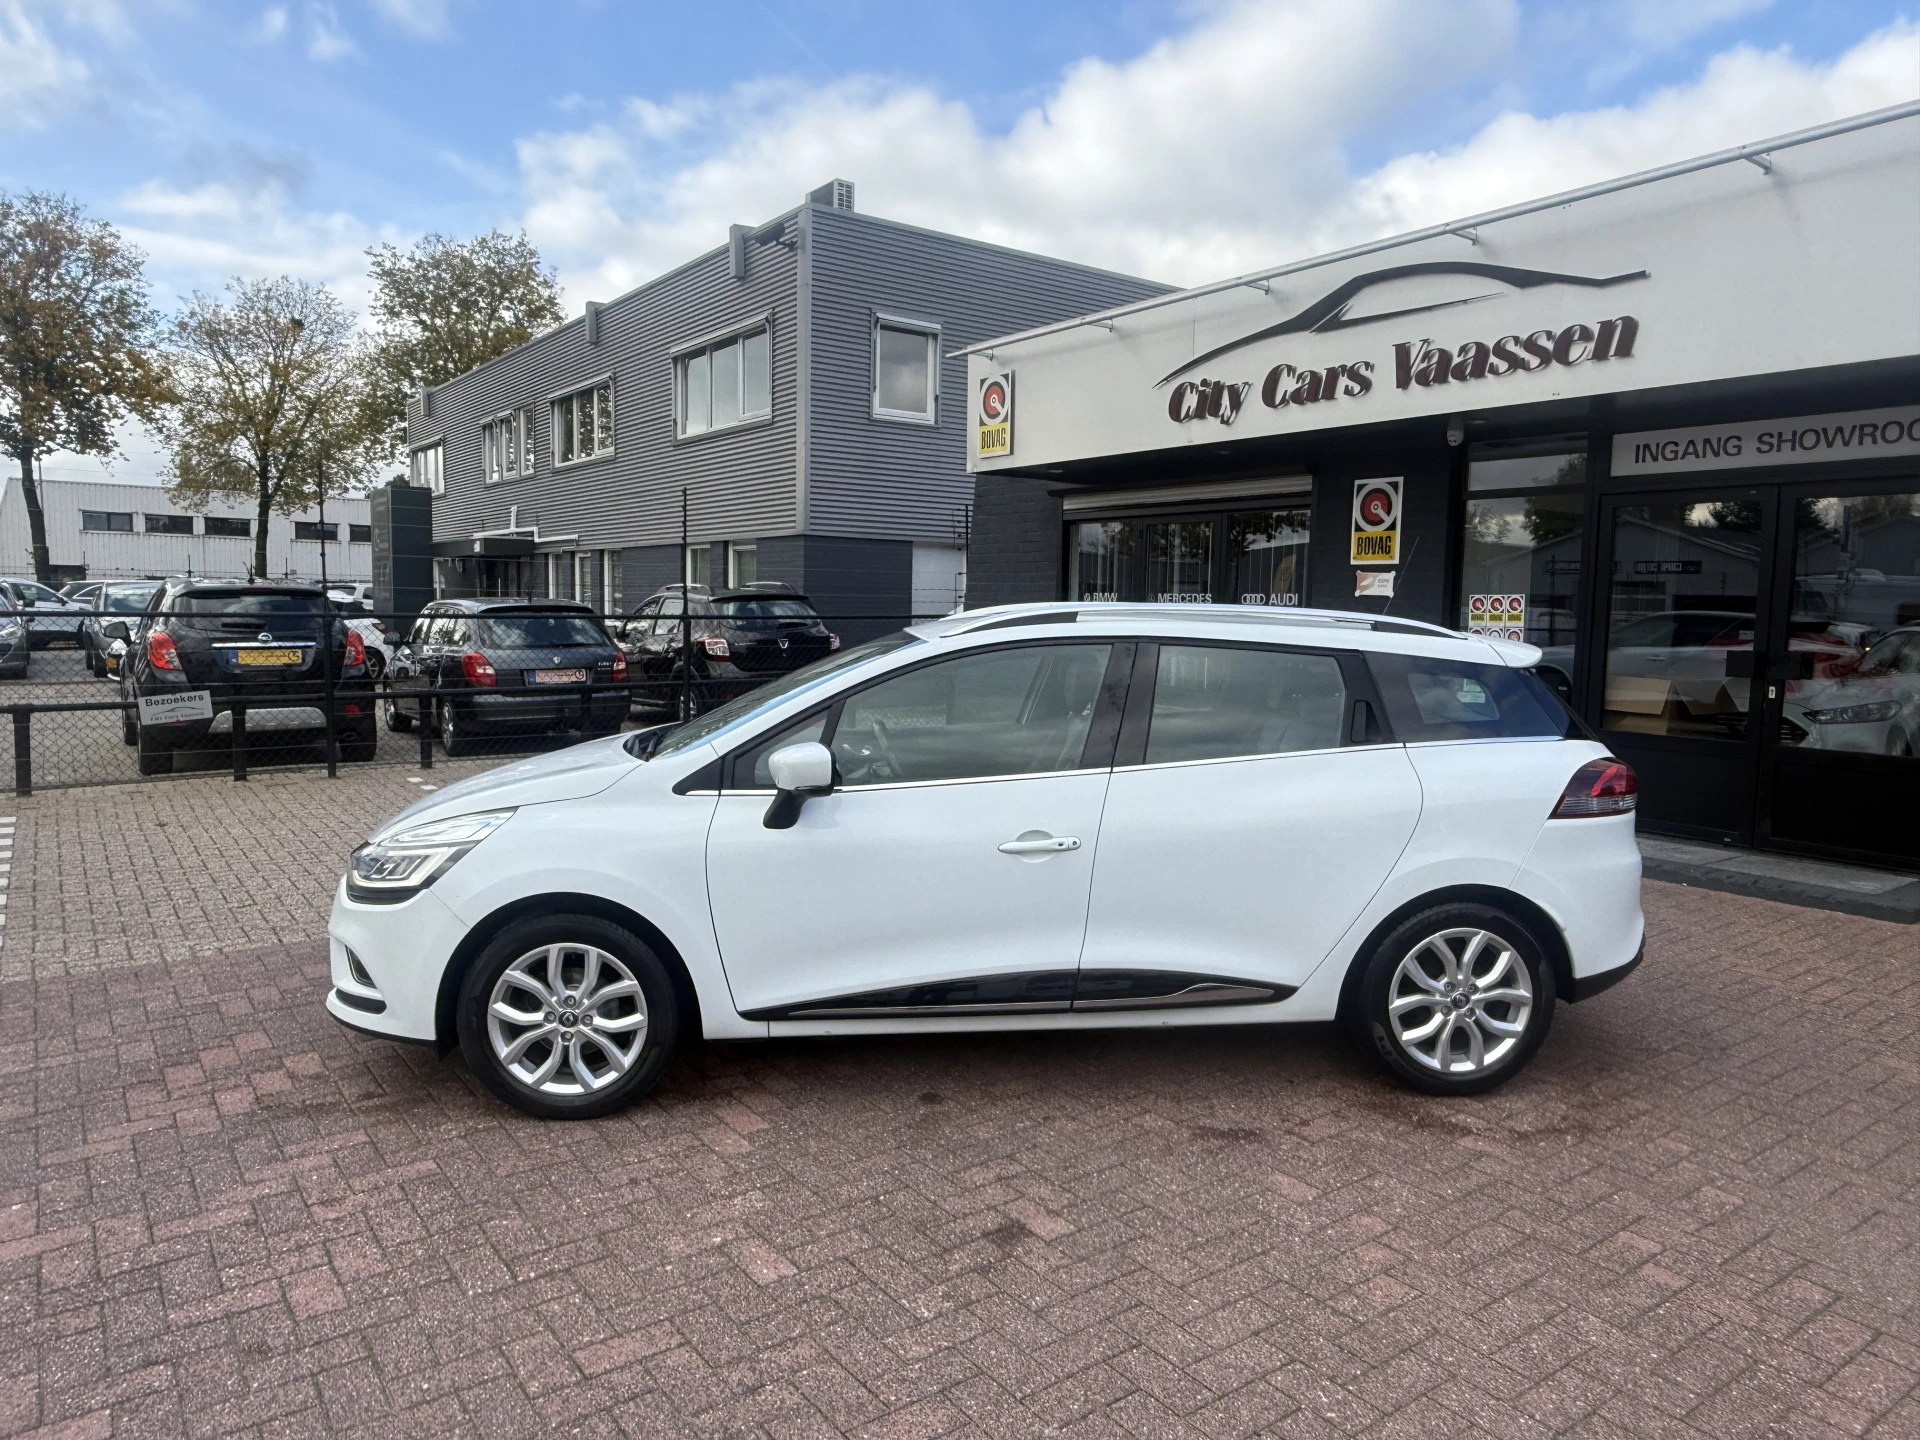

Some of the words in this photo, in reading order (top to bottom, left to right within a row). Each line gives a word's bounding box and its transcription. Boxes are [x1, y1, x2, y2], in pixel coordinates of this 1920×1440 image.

[1168, 377, 1251, 425] City
[1261, 360, 1373, 409] Cars
[1392, 315, 1639, 389] Vaassen
[981, 427, 1006, 450] BOVAG
[1634, 435, 1743, 463] INGANG
[1356, 535, 1392, 556] BOVAG
[1093, 592, 1118, 602] BMW
[1157, 593, 1212, 604] MERCEDES
[1268, 593, 1299, 606] AUDI
[145, 694, 204, 707] Bezoekers
